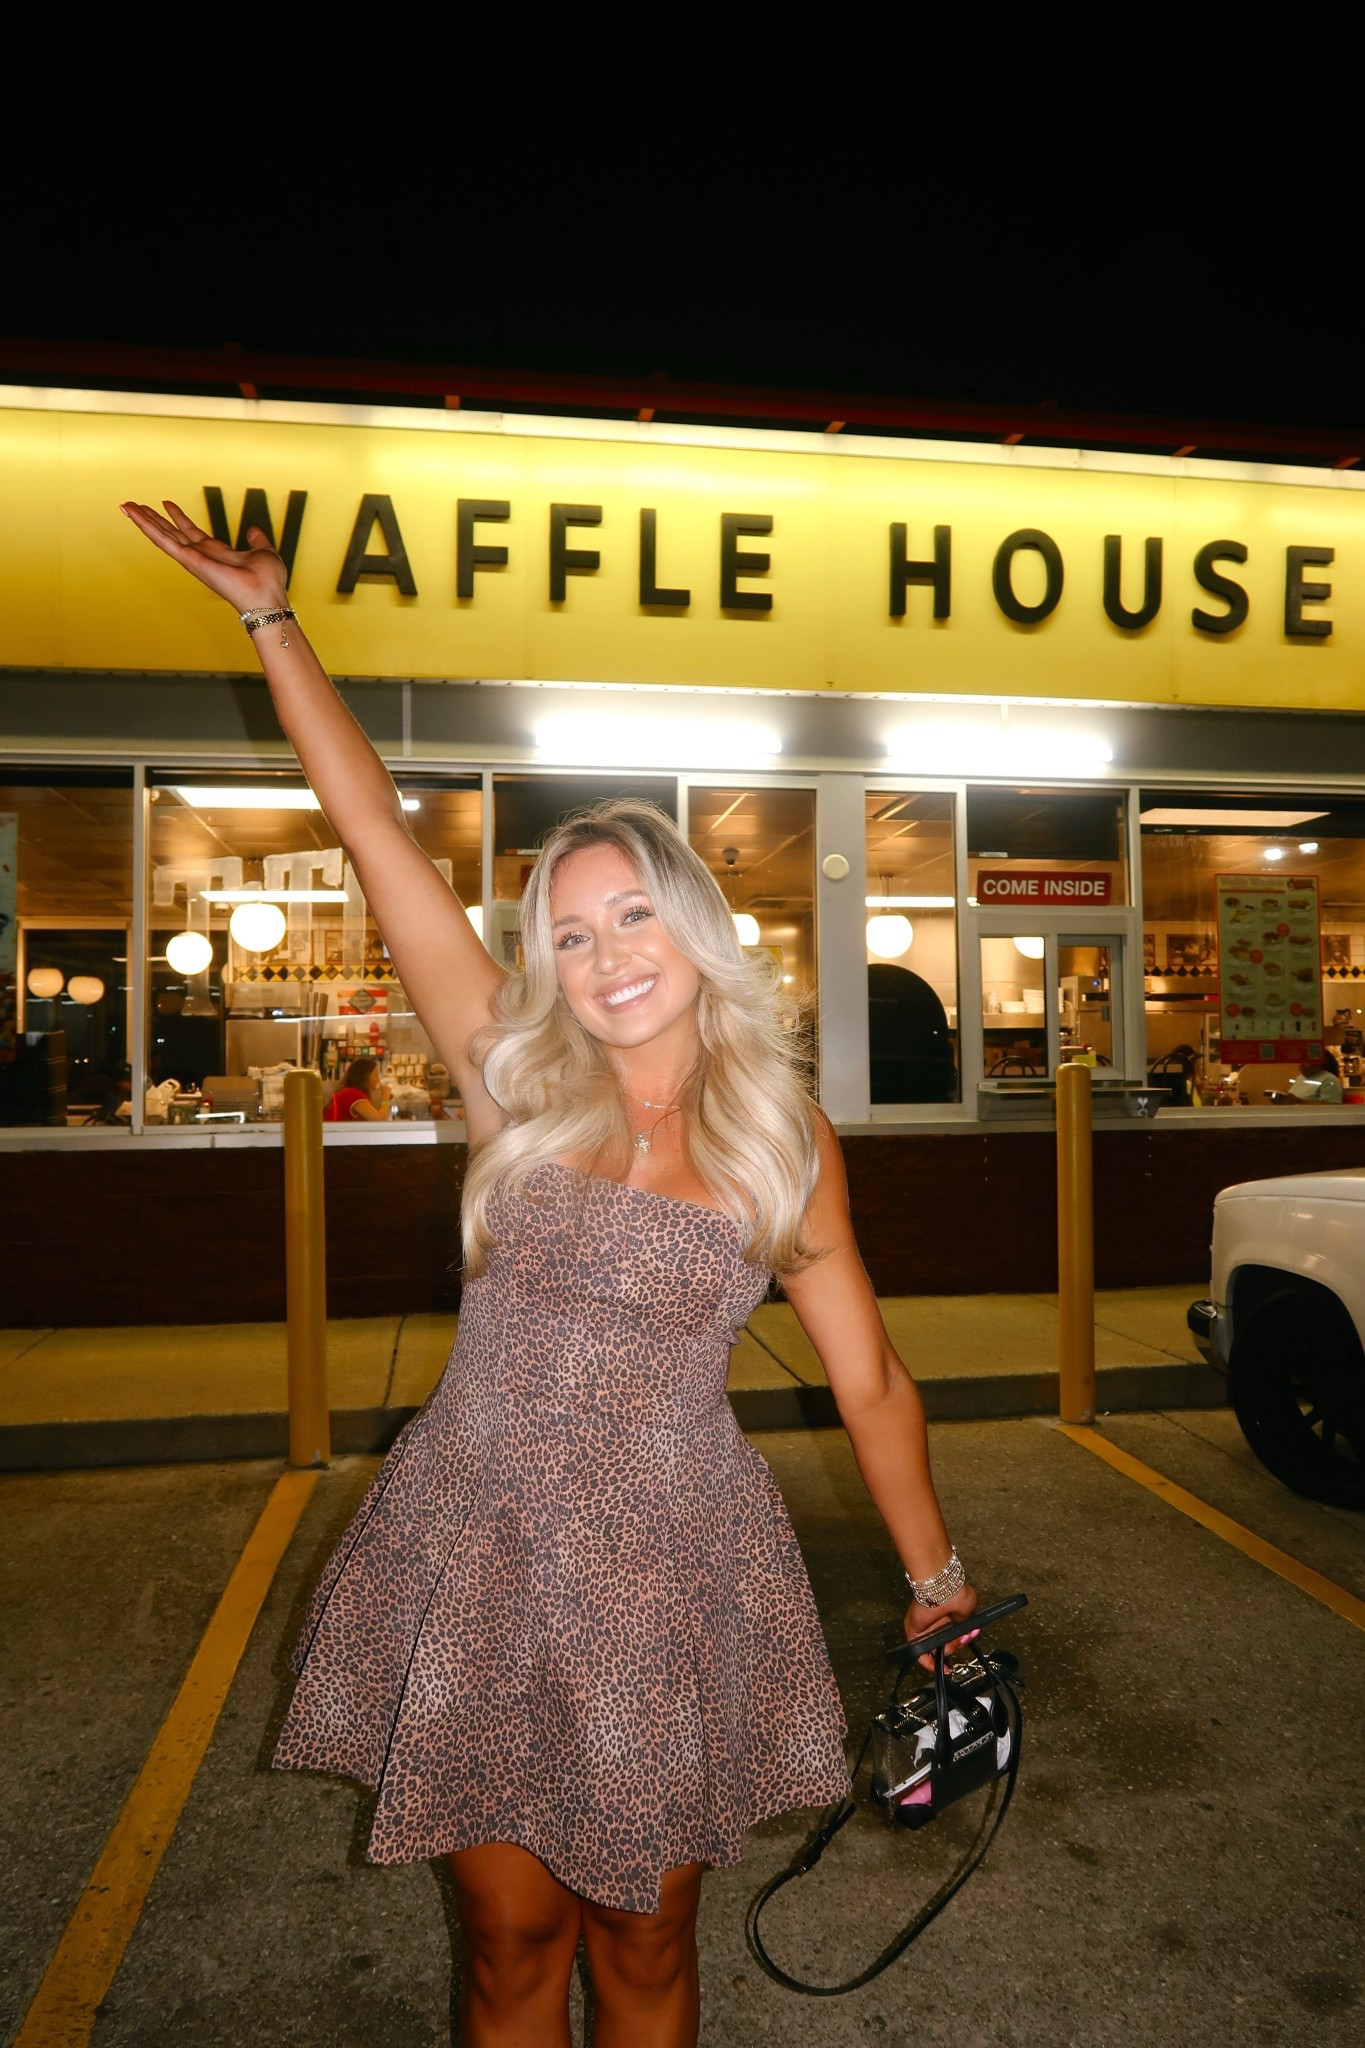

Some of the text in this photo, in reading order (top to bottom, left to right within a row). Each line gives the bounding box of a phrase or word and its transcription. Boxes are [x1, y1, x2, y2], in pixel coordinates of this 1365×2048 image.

[203, 486, 1335, 638] WAFFLE HOUSE
[983, 879, 1105, 896] COME INSIDE
